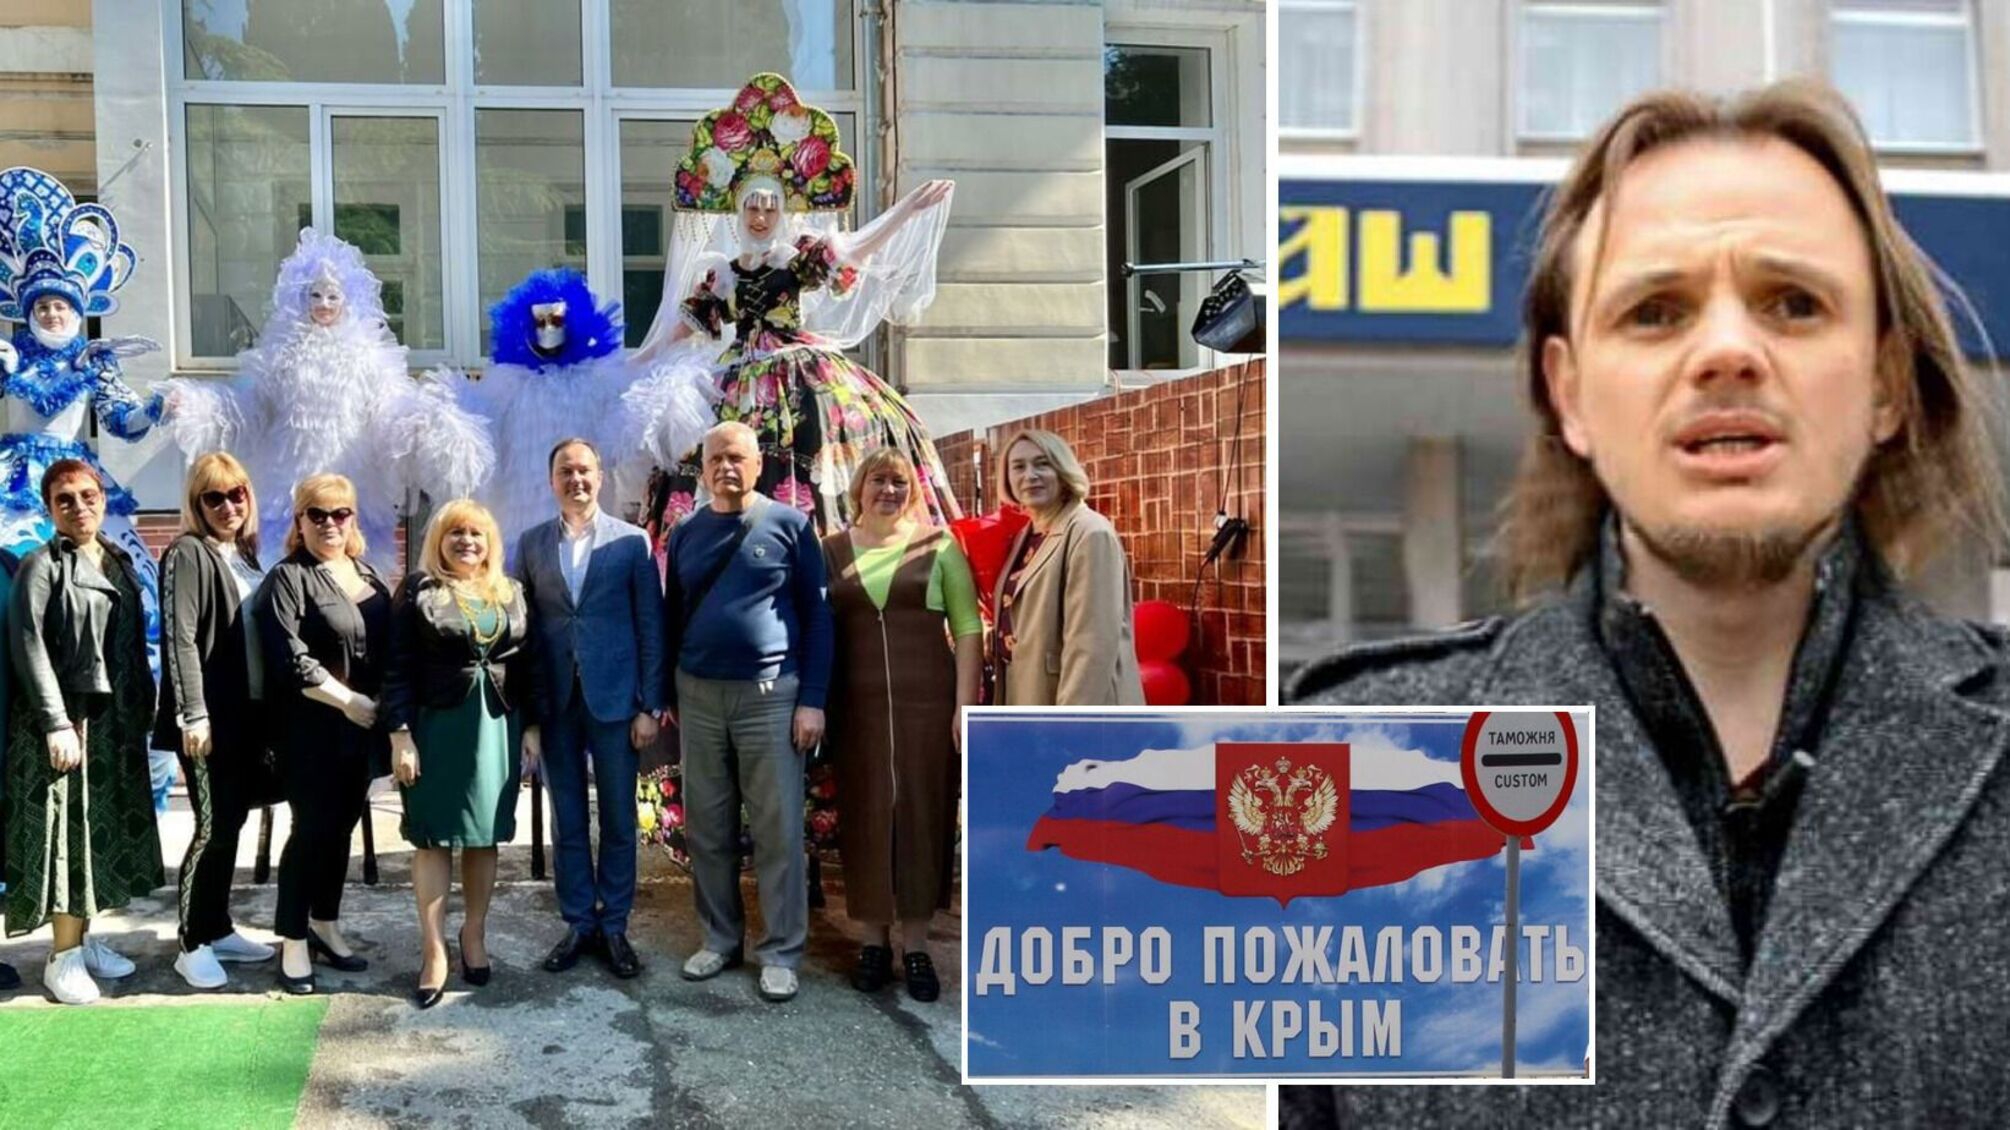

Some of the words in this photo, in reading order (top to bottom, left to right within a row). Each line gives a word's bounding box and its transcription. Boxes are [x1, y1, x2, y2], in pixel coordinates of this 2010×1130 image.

[1489, 730, 1556, 745] ТАМОЖНЯ
[1494, 773, 1548, 788] CUSTOM
[976, 926, 1172, 996] ДОБРО
[1203, 924, 1586, 985] ПОЖАЛОВАТЬ
[1169, 1000, 1202, 1059] В
[1233, 999, 1402, 1058] КРЫМ
